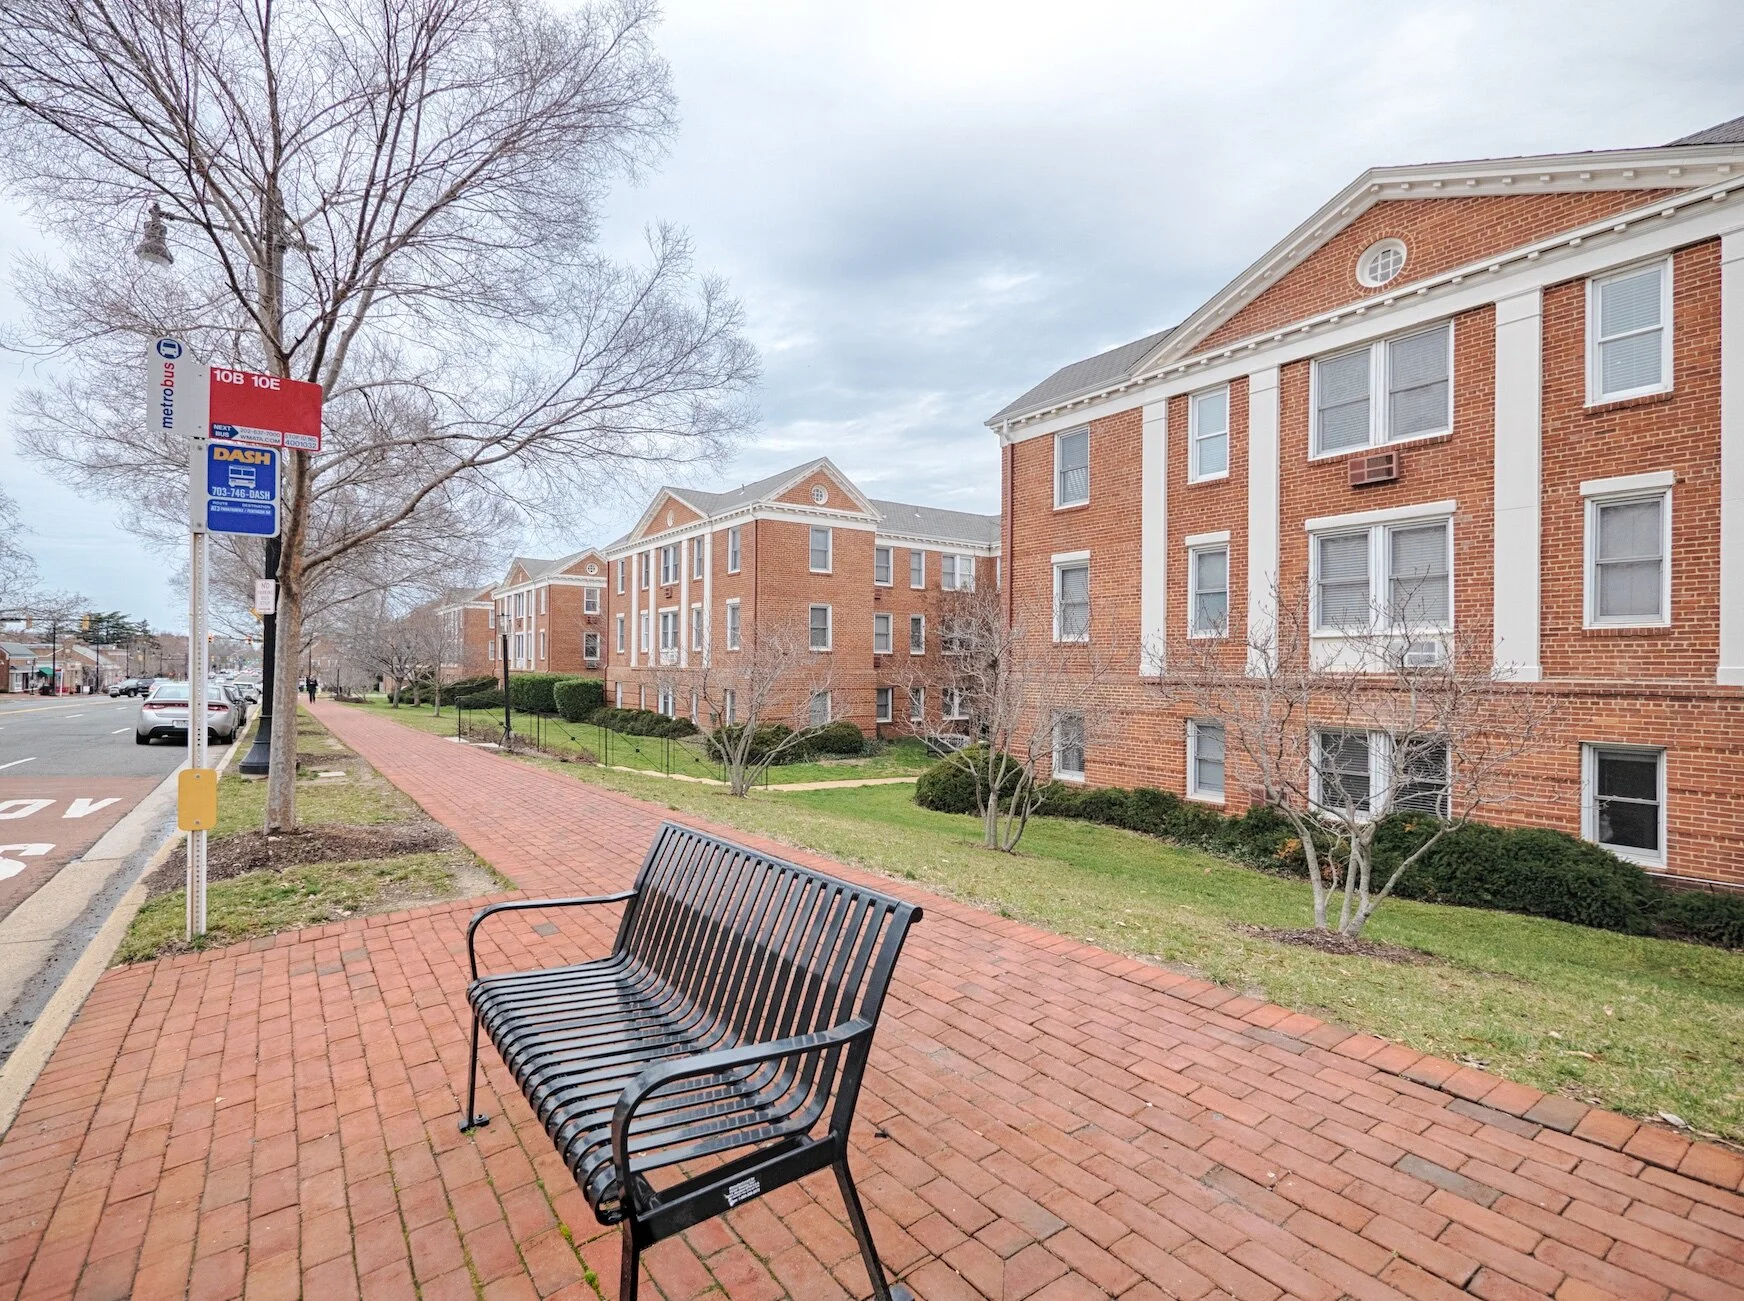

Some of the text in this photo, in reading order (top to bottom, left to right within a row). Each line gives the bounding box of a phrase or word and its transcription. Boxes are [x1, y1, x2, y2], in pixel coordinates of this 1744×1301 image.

[213, 370, 281, 391] 10B 10E
[160, 362, 175, 429] metrobus
[240, 434, 281, 444] WMATA.COM
[285, 439, 317, 449] 4001032
[213, 447, 271, 466] DASH
[212, 486, 271, 500] 703-746-DASH
